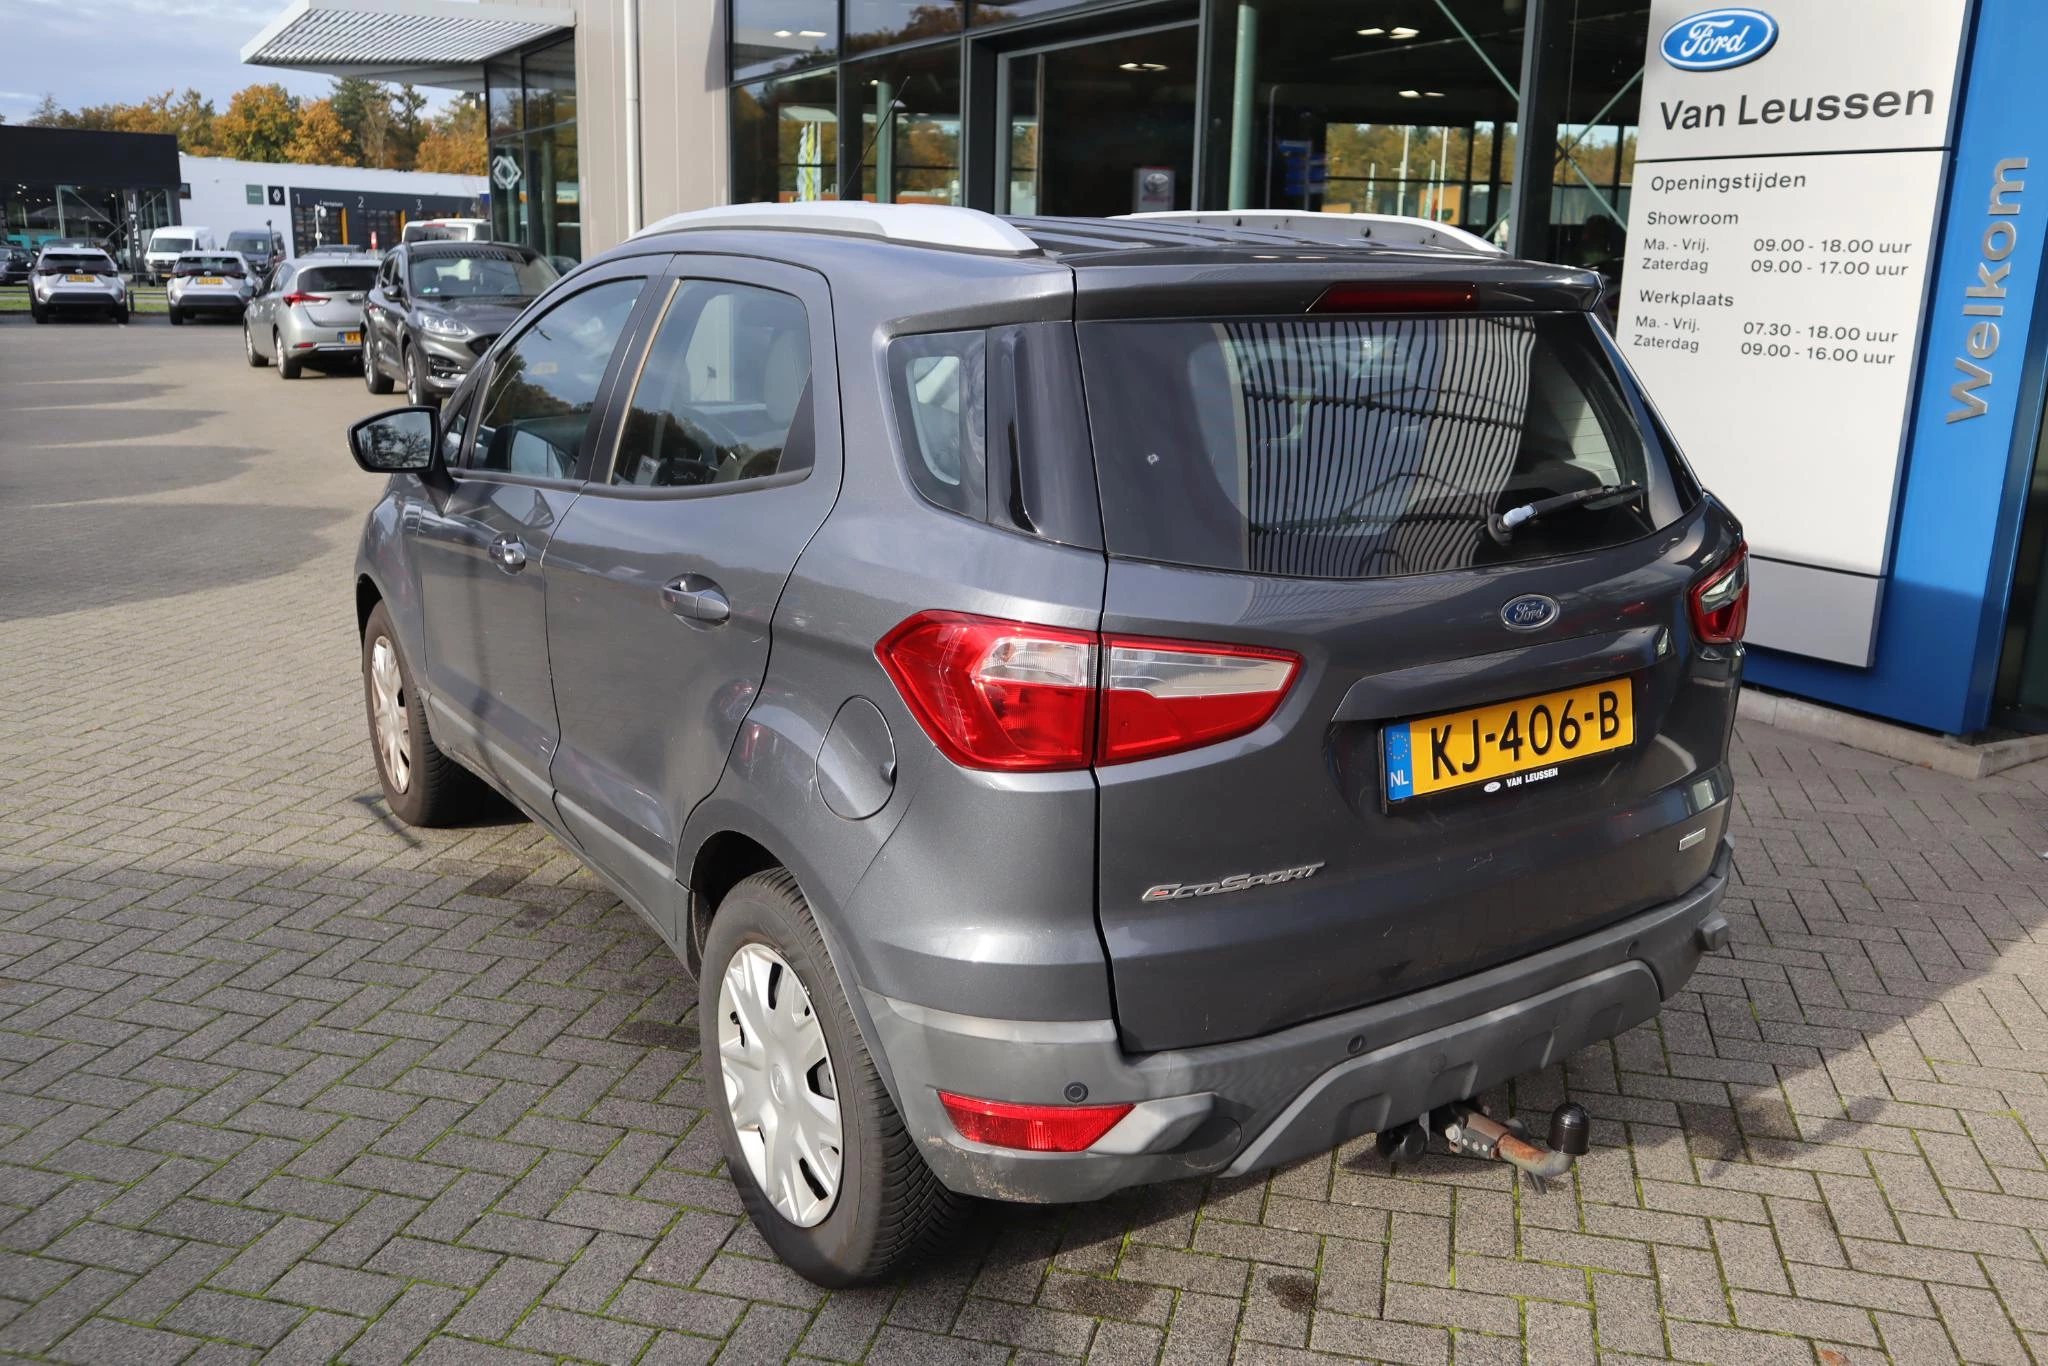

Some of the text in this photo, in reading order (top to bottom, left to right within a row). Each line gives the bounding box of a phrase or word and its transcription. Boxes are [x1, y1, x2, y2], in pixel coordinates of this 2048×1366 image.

[1680, 19, 1751, 57] Ford
[1660, 87, 1934, 130] Van Leussen
[1651, 172, 1806, 194] Openingstijden
[1647, 211, 1739, 225] Showroom
[1644, 238, 1669, 250] Ma.
[1682, 238, 1710, 254] Vrij.
[1753, 238, 1804, 252] 09.00
[1821, 239, 1874, 253] 18.00
[1879, 242, 1912, 253] uur
[1642, 257, 1709, 274] Zaterdag
[1751, 259, 1803, 273] 09.00
[1819, 261, 1870, 275] 17.00
[1875, 264, 1909, 276] uur
[1639, 289, 1735, 308] Werkplaats
[1945, 157, 2029, 424] Welkom
[1635, 315, 1660, 328] Ma.
[1673, 317, 1701, 334] Vrij.
[1743, 321, 1791, 337] 07.30
[1808, 325, 1860, 341] 18.00
[1866, 331, 1899, 343] uur
[1633, 334, 1700, 353] Zaterdag
[1741, 342, 1791, 358] 09.00
[1807, 346, 1858, 362] 16.00
[1863, 353, 1895, 365] uur
[1430, 690, 1620, 781] KJ-406-B
[1390, 769, 1409, 787] NL
[1506, 776, 1522, 788] VAN
[1525, 767, 1558, 783] LEUSSEN
